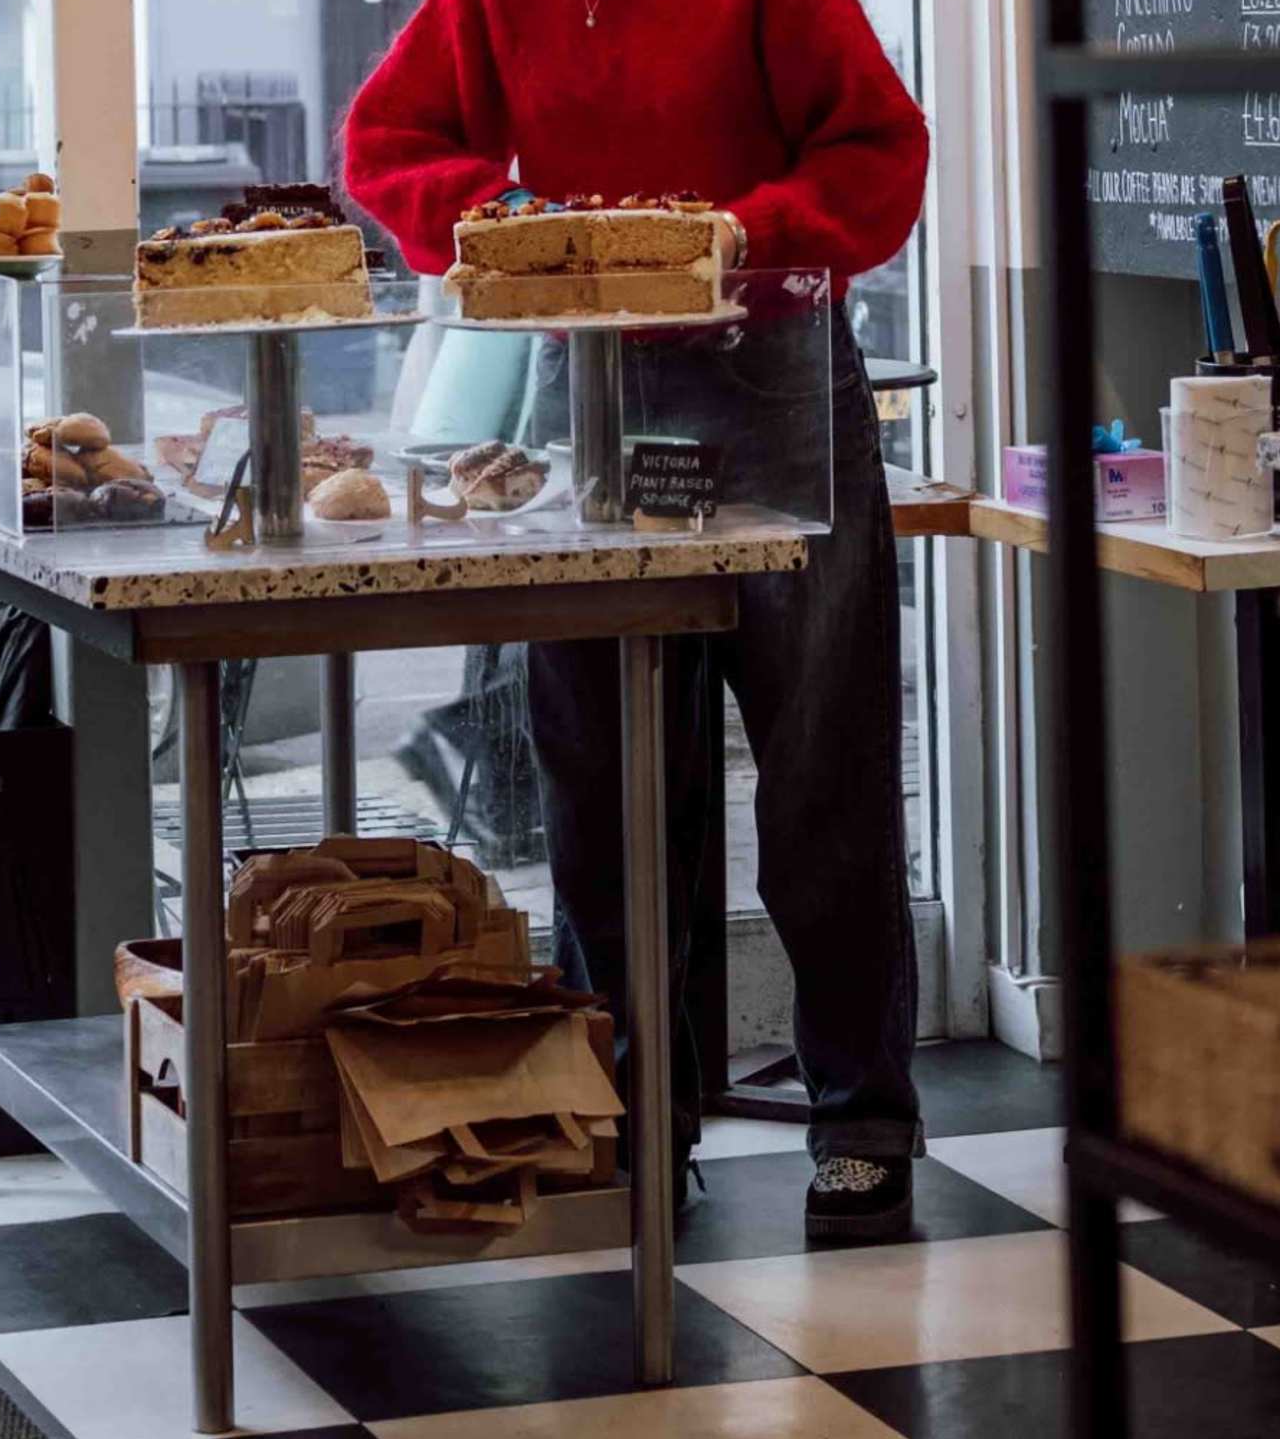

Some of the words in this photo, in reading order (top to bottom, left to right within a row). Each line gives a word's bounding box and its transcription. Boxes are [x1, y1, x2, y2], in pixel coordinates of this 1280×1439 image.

[1121, 169, 1151, 204] COFFEE
[1152, 171, 1179, 205] BEANS
[1180, 175, 1196, 206] ARE
[1251, 175, 1278, 206] NEW
[641, 452, 700, 471] VICTORIA
